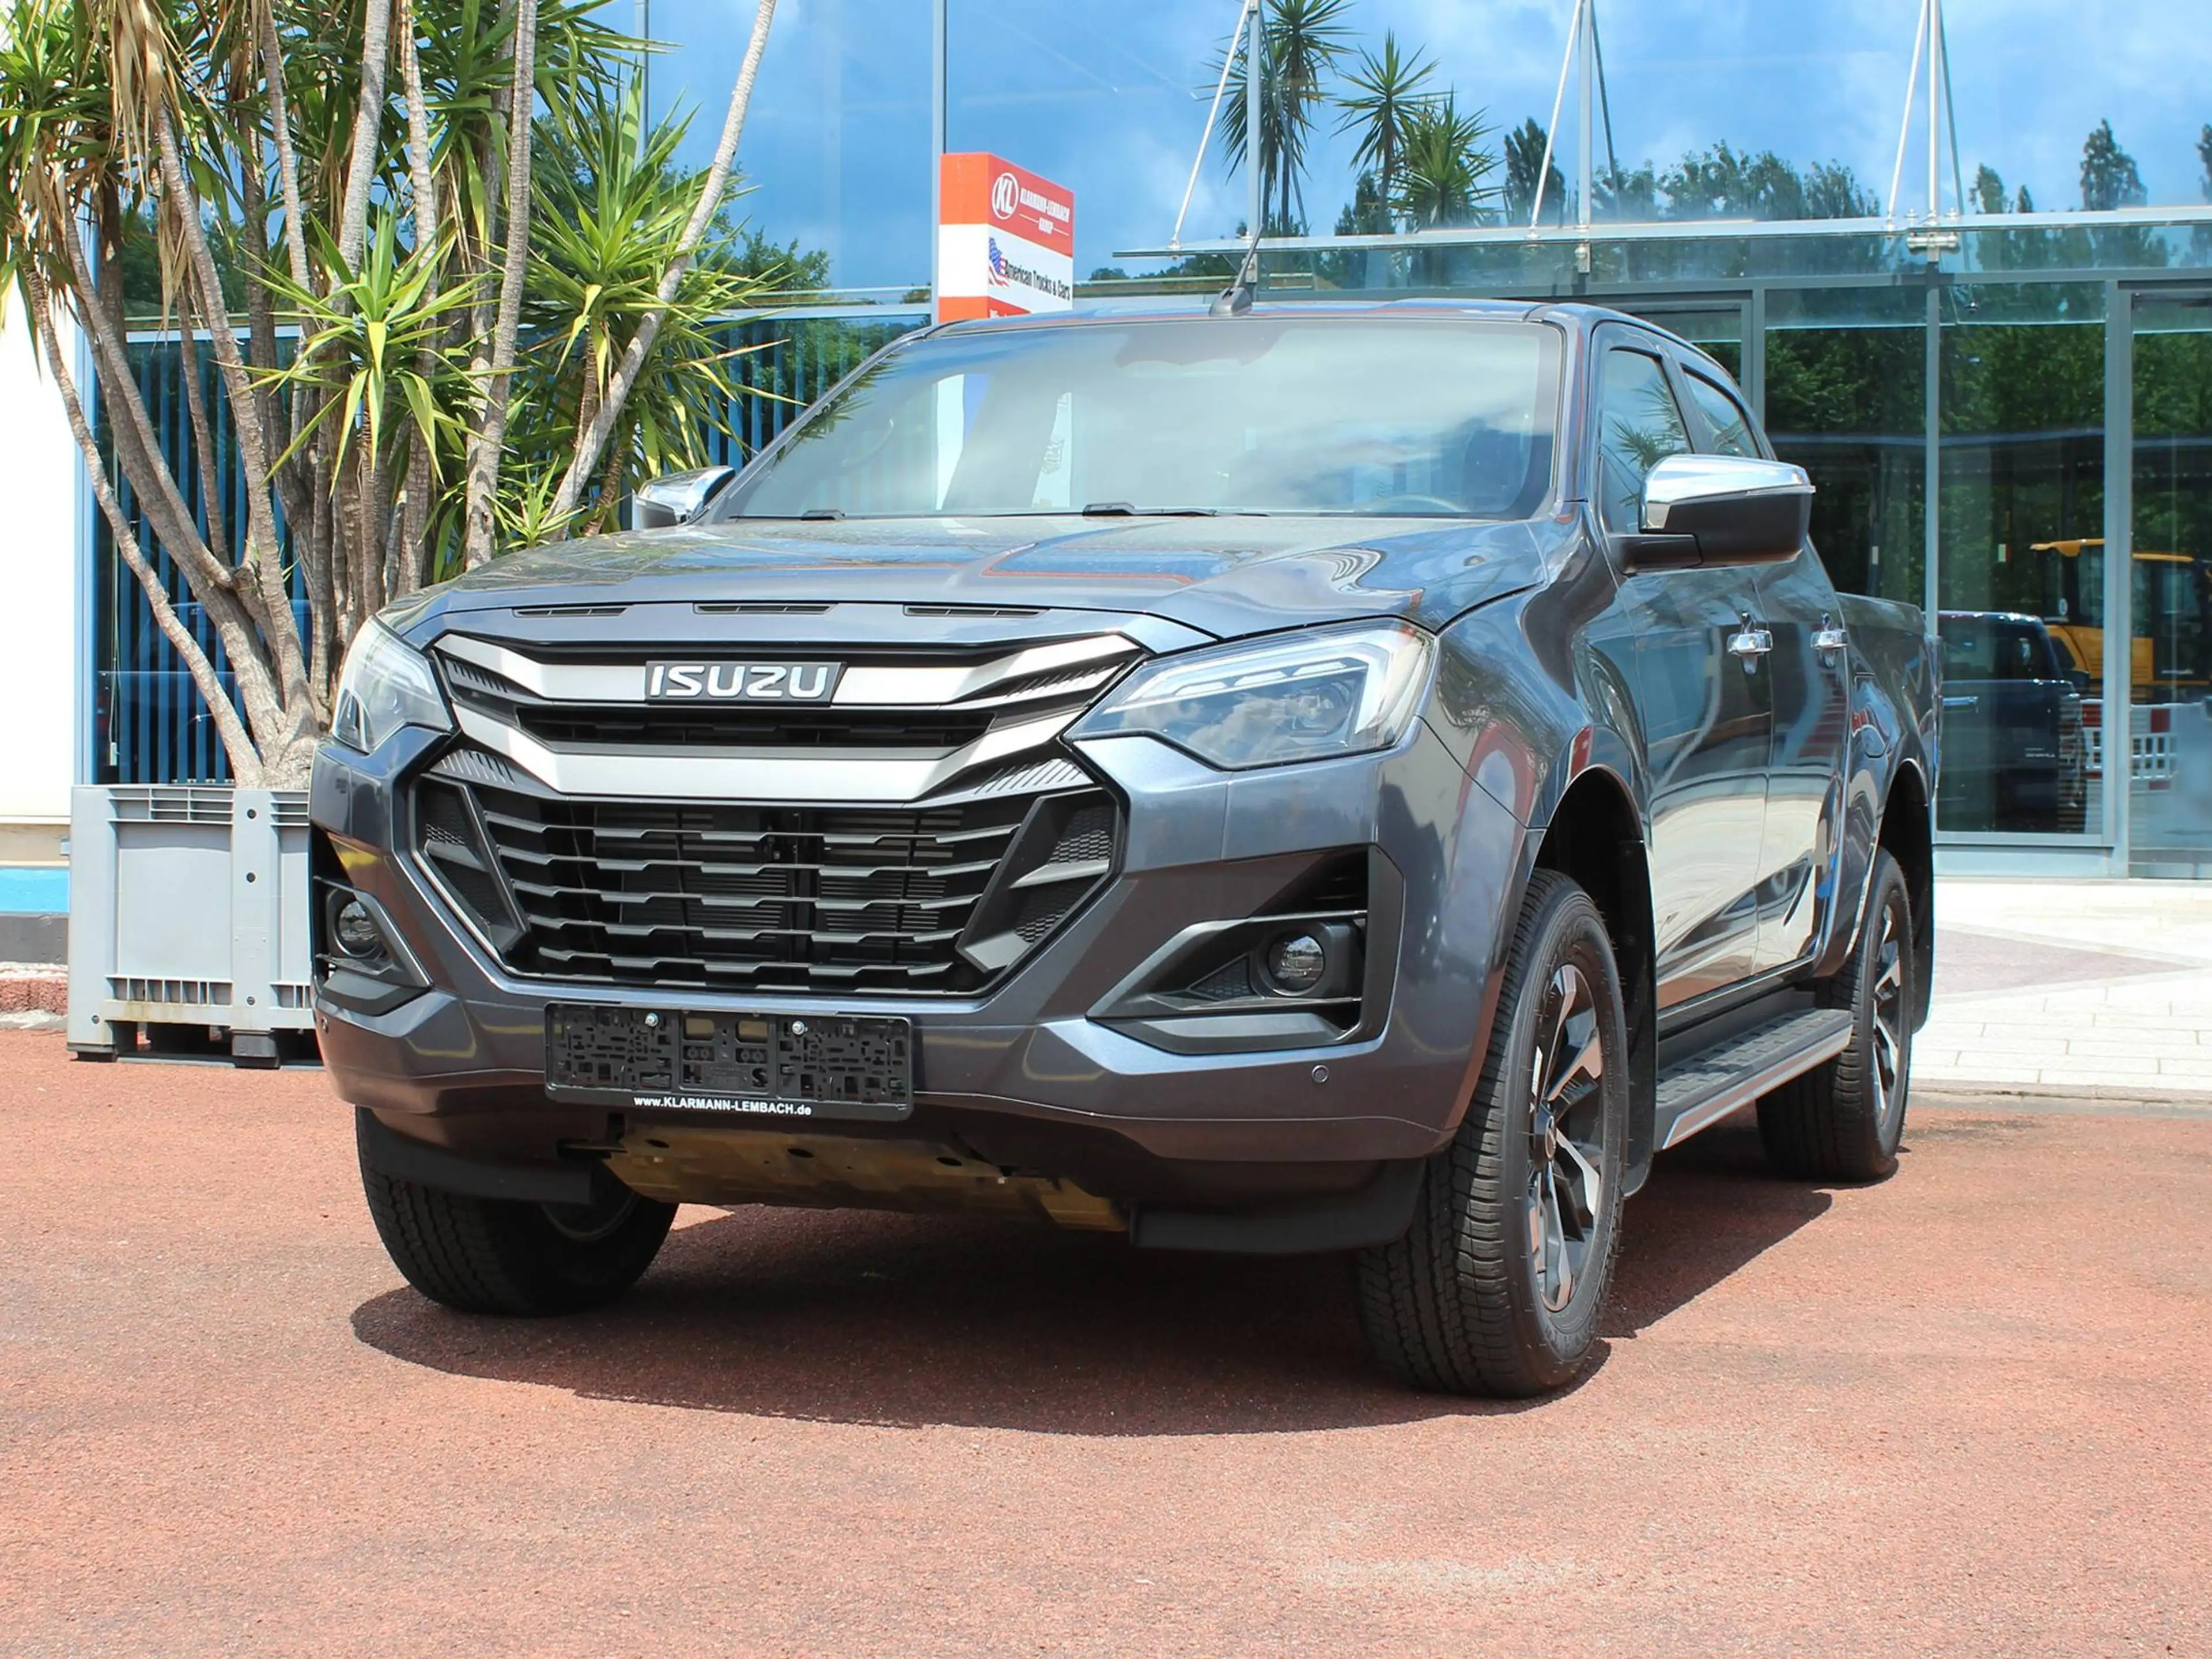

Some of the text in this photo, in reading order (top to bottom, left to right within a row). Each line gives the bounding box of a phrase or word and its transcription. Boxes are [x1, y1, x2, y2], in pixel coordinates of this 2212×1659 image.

[1003, 260, 1033, 286] American
[1033, 270, 1052, 294] Trucks
[1058, 280, 1071, 301] Cars
[650, 665, 829, 698] ISUZU
[634, 1096, 812, 1116] www.KLARMANN-LEMBACH.de
